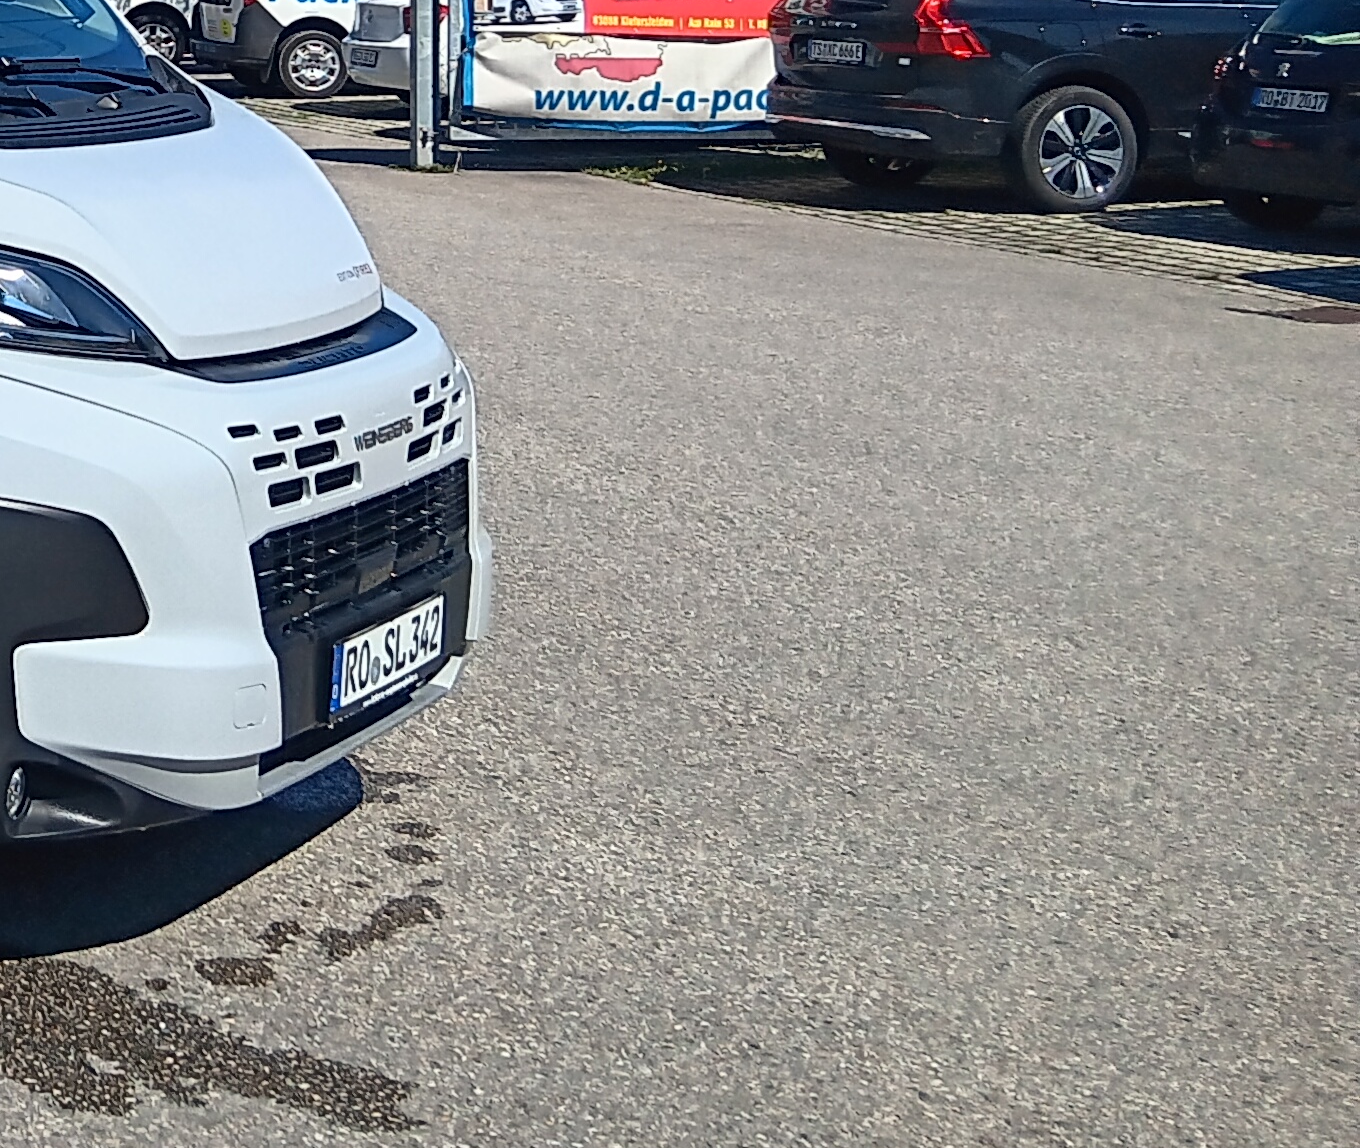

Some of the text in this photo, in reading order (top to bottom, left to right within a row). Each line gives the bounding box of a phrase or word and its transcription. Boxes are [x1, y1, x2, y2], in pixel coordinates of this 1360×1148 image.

[534, 81, 769, 119] www.d-a-pac
[344, 640, 371, 698] RO
[383, 624, 407, 677] SL
[408, 604, 440, 663] 342
